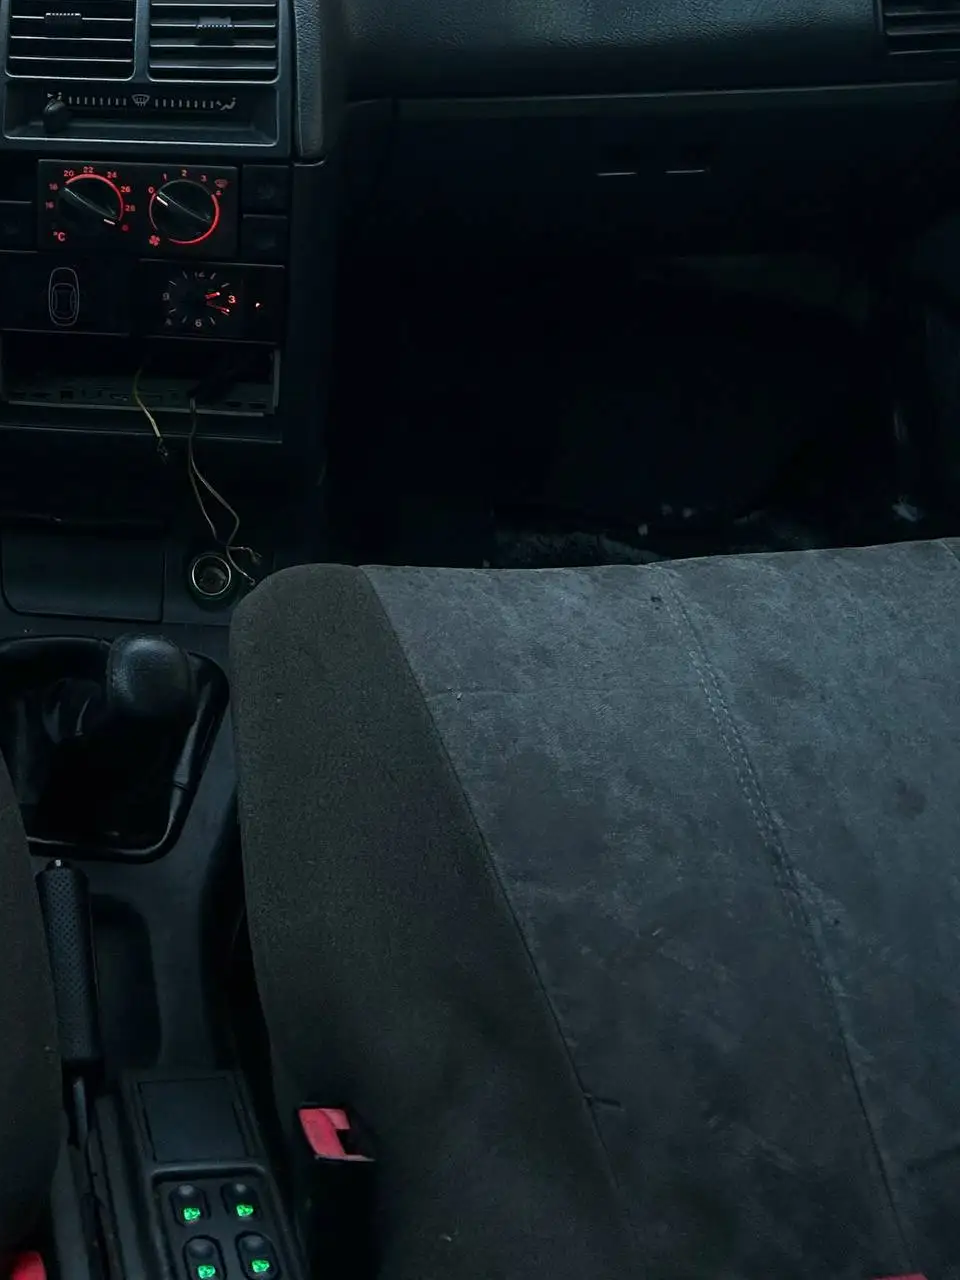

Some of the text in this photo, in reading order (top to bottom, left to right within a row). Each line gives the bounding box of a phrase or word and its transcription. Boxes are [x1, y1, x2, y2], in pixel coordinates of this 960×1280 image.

[63, 169, 76, 178] 20
[181, 169, 188, 177] 2
[161, 291, 170, 302] 9
[227, 294, 237, 304] 3
[193, 318, 203, 328] 6
